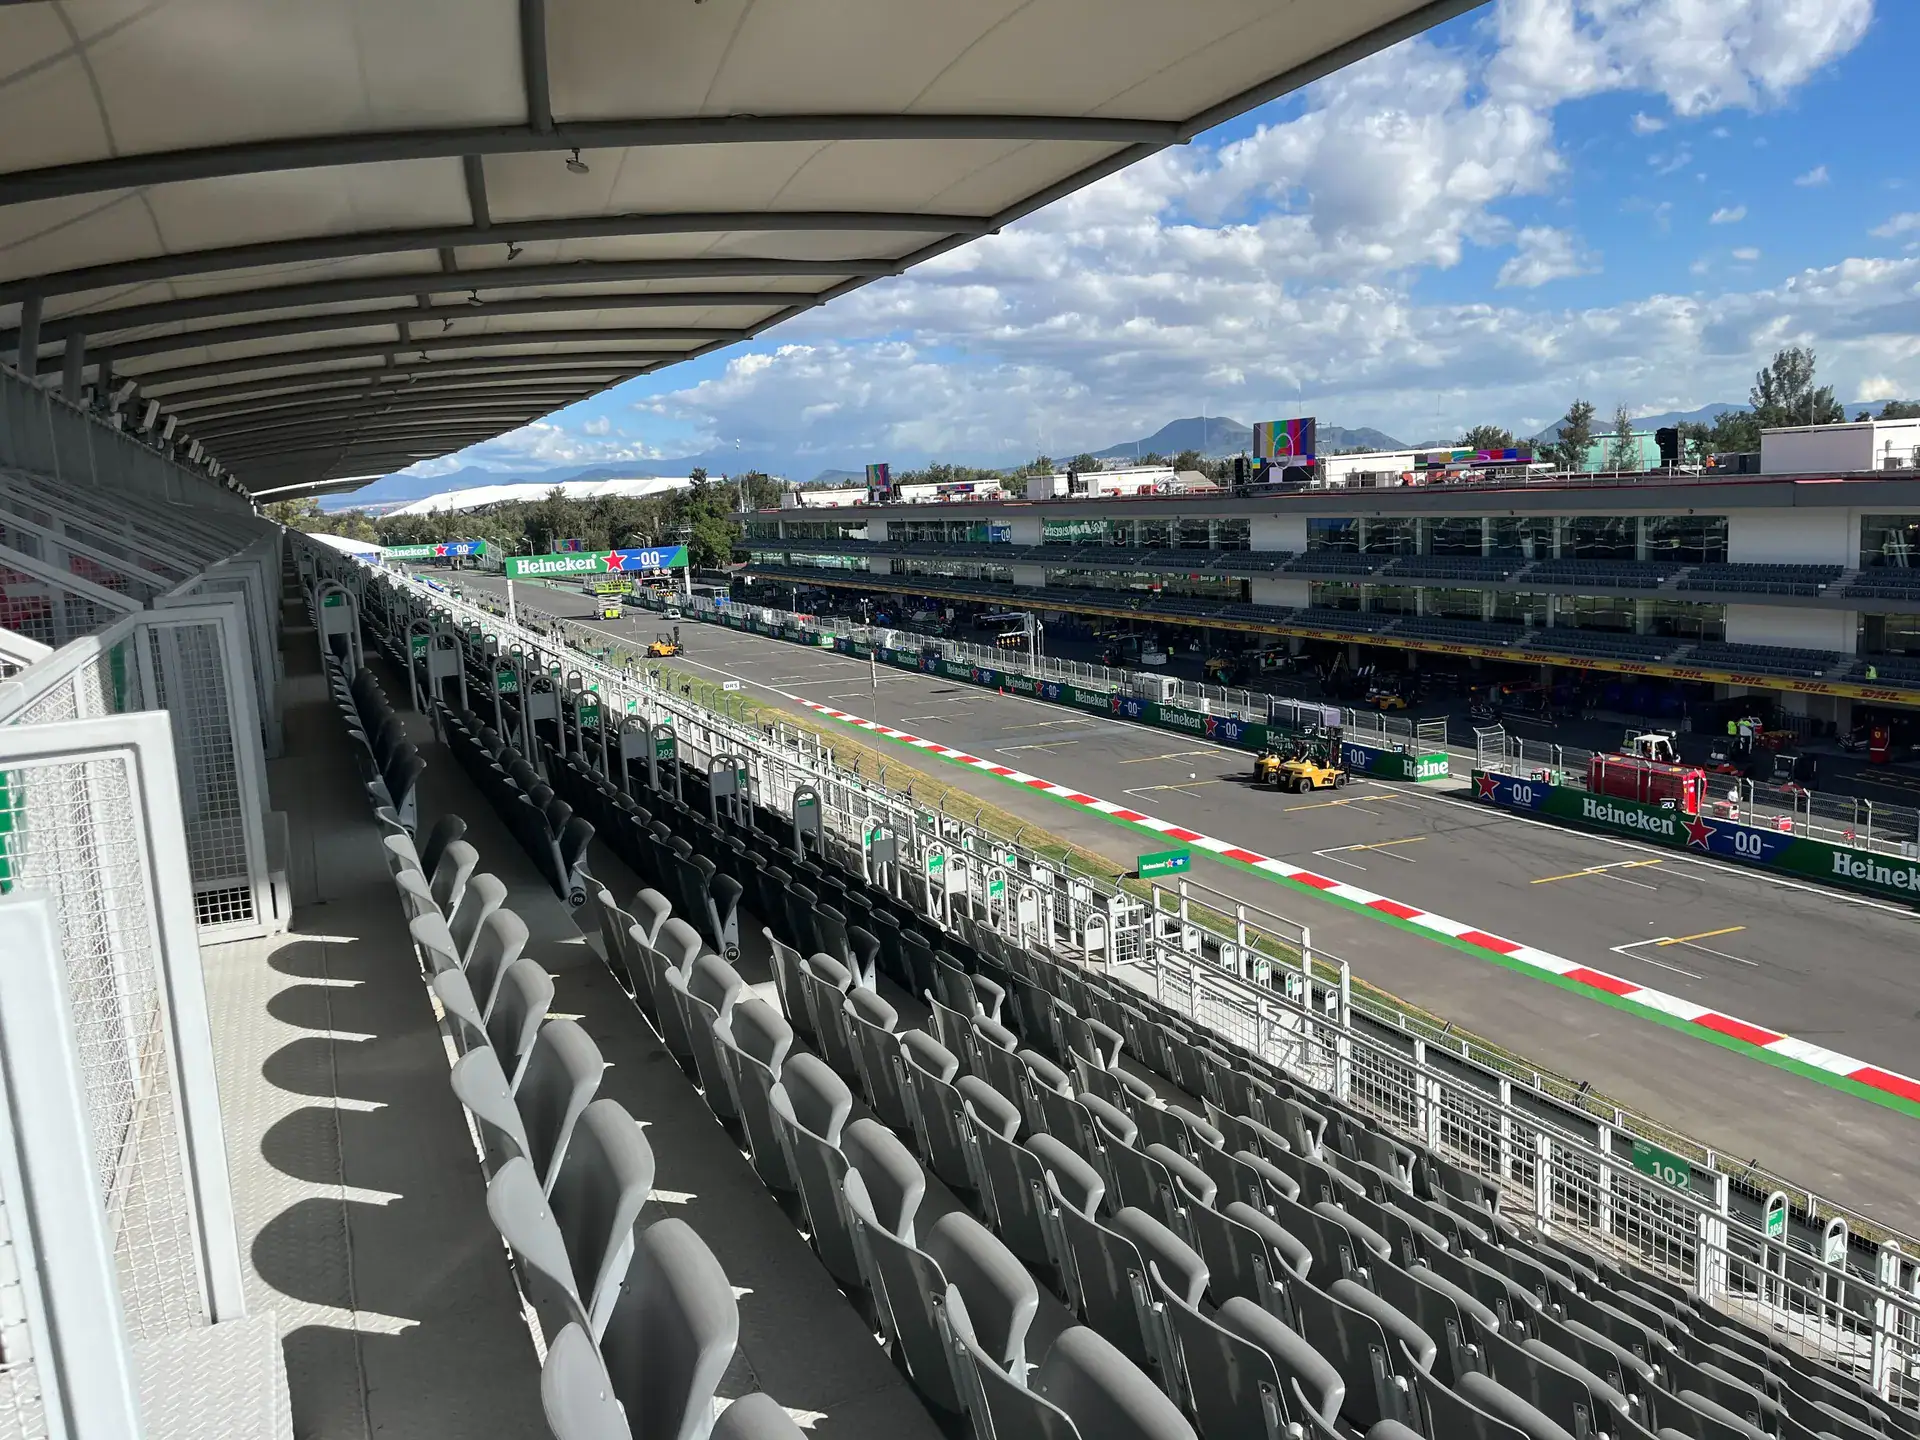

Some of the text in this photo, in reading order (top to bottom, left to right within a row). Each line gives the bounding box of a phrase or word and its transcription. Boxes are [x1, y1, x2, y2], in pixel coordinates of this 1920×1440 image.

[516, 556, 597, 575] Heineken
[1370, 637, 1388, 645] DHL
[1441, 644, 1463, 653] DHL
[1482, 649, 1504, 657] DHL
[1524, 653, 1548, 662] DHL
[1569, 658, 1596, 667] DHL
[1620, 663, 1647, 673] DHL
[1672, 669, 1703, 679] DHL
[1730, 674, 1764, 685] DHL
[1005, 675, 1033, 690] Heineken
[1793, 681, 1829, 693] DHL
[1075, 690, 1108, 708] Heineken
[1860, 689, 1900, 700] DHL
[1160, 708, 1201, 729] Heineken
[1351, 749, 1365, 765] 0.0
[1513, 784, 1532, 803] 0.0
[1661, 801, 1675, 809] 20
[1582, 797, 1676, 836] Heineken
[1735, 831, 1762, 855] 0.0
[1652, 1161, 1690, 1192] 102
